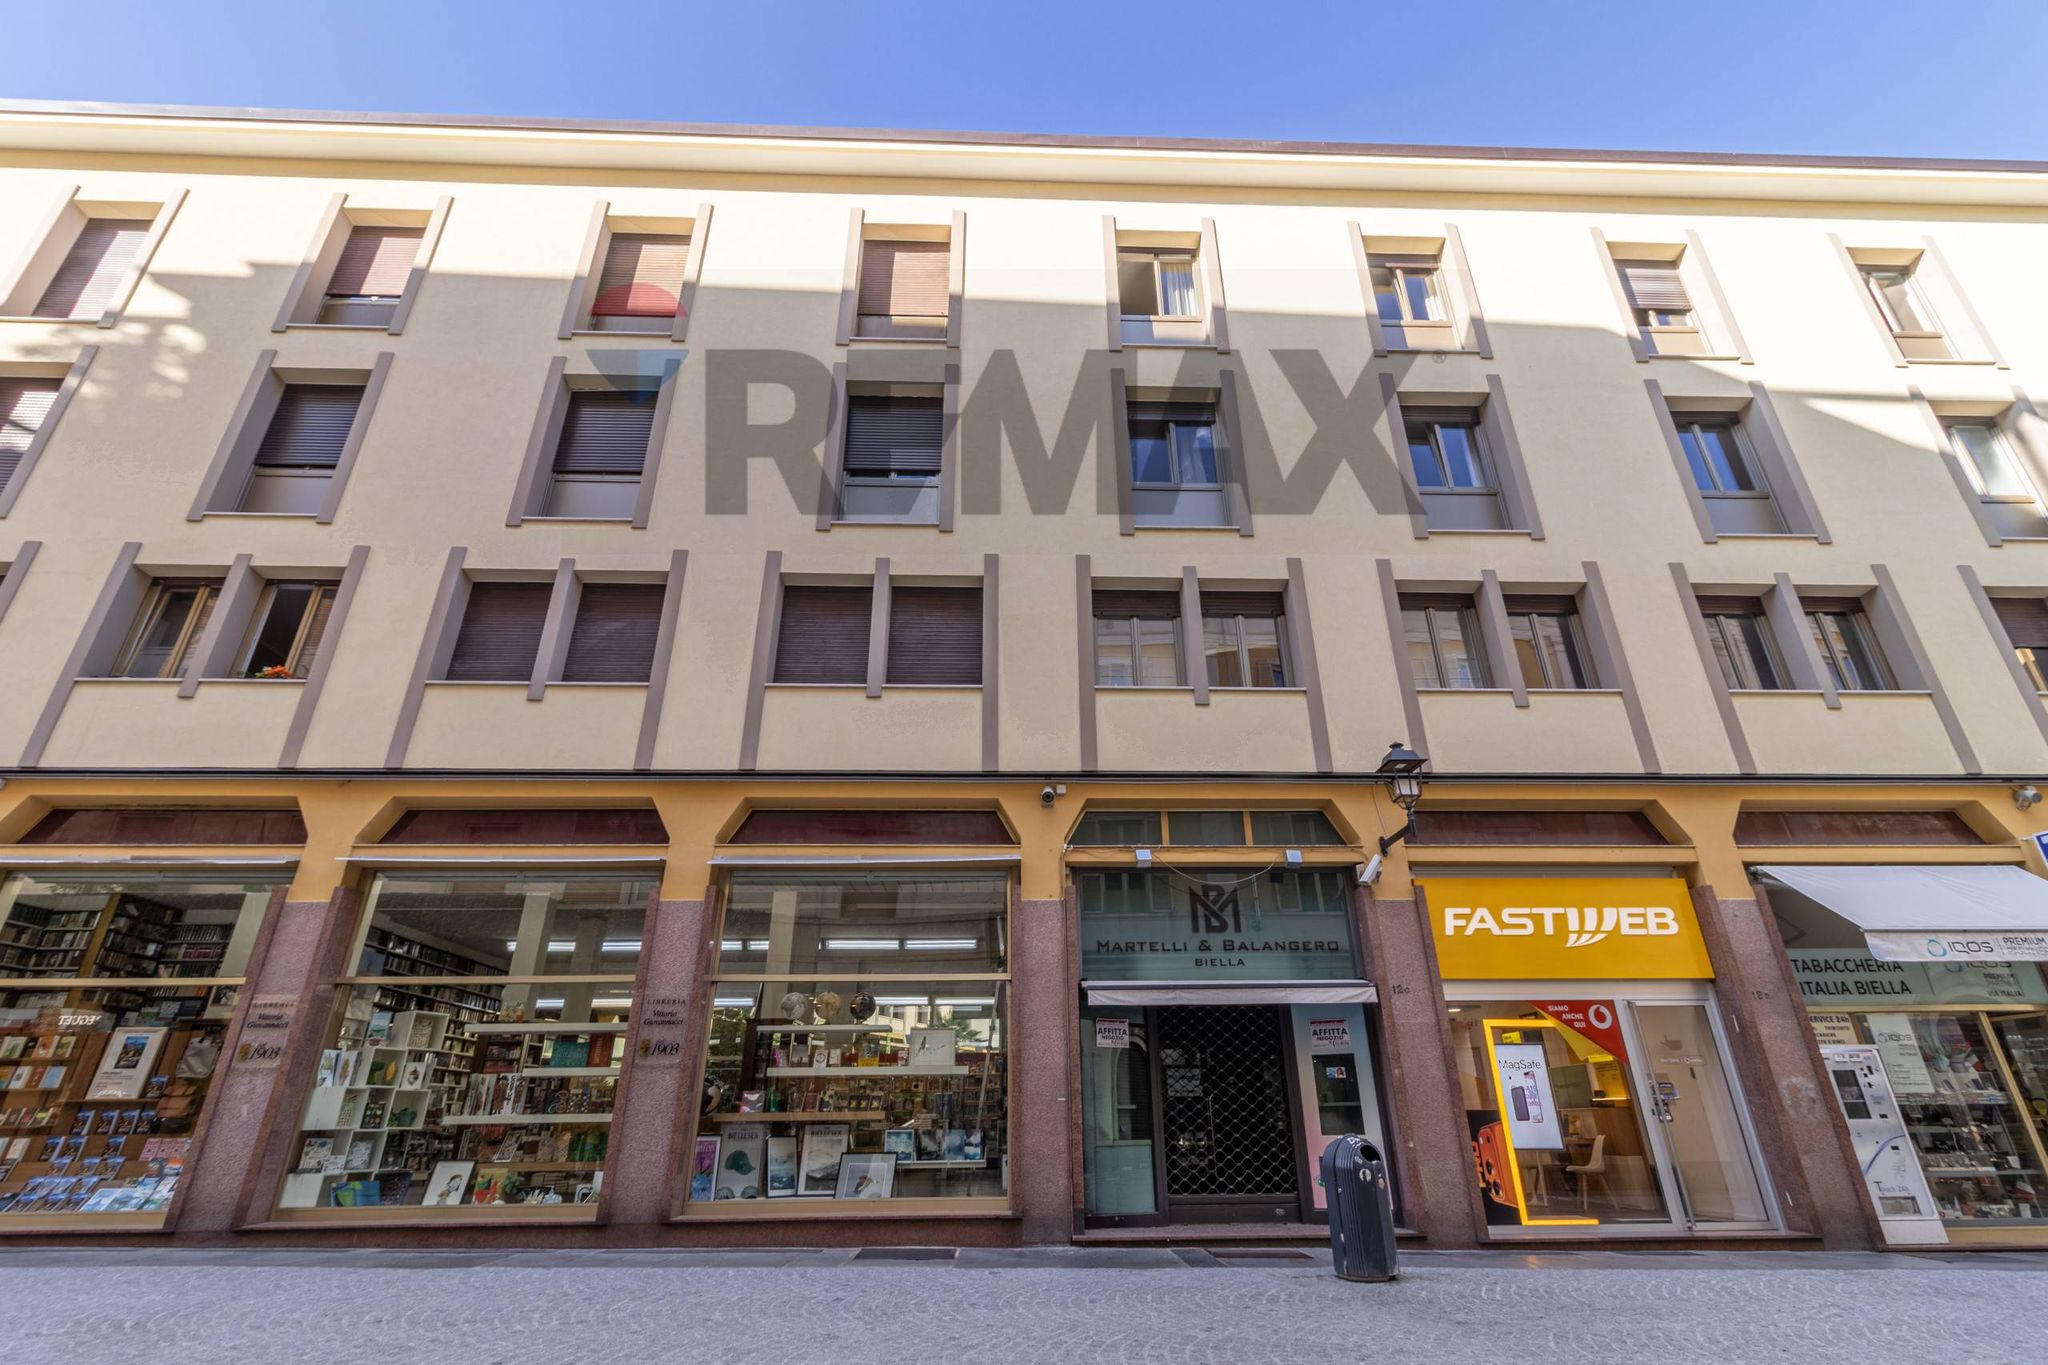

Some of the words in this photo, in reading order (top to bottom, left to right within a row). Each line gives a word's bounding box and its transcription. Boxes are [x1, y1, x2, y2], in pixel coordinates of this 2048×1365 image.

[1444, 907, 1679, 947] FASTWEB
[1097, 940, 1187, 952] MARTELLI
[1198, 939, 1212, 951] &
[1223, 940, 1339, 952] BALANGERO
[1947, 941, 1994, 954] IQOS
[2002, 937, 2047, 946] PREMIUM
[1195, 958, 1245, 967] BIELLA
[1790, 959, 1904, 972] TABACCHERIA
[1800, 981, 1852, 995] ITALIA
[1855, 981, 1912, 994] BIELLA
[1098, 1028, 1127, 1036] AFFITTA
[1312, 1028, 1348, 1036] AFFITTA
[249, 1046, 281, 1060] 1903
[651, 1042, 681, 1057] 1903
[1498, 1060, 1542, 1071] MagSafe
